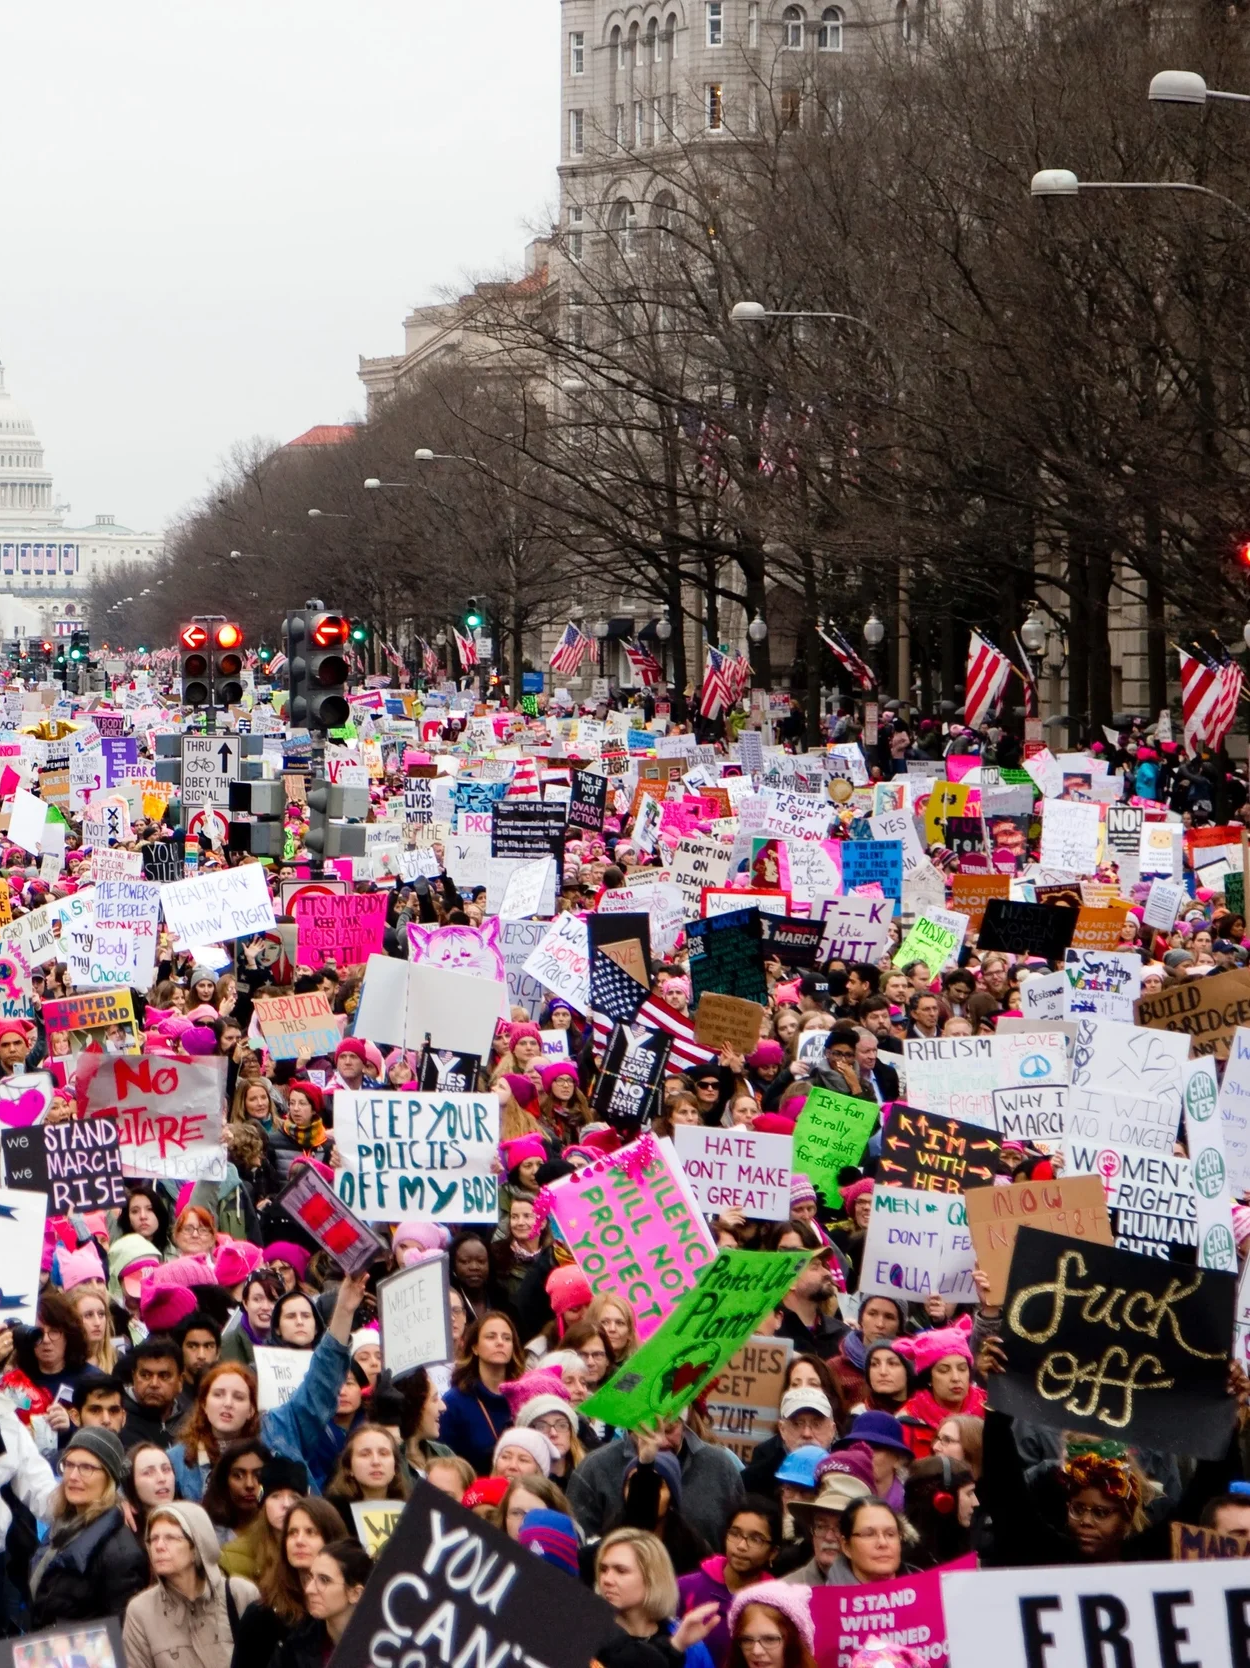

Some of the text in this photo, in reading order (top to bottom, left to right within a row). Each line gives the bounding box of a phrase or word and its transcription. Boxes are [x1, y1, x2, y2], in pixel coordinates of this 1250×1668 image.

[186, 741, 211, 751] THRU
[126, 766, 147, 777] FEAR
[577, 772, 598, 781] this
[982, 769, 999, 784] NO!
[185, 777, 210, 787] OBEY
[405, 778, 431, 793] BLACK
[581, 782, 601, 794] NOT
[405, 795, 432, 808] LIVES
[571, 802, 602, 814] OVARY
[776, 791, 825, 810] TRUMP
[407, 811, 432, 823] MATTER
[569, 813, 602, 827] ACTION
[777, 802, 826, 819] IS GUILTY
[768, 817, 823, 839] TREASON
[879, 818, 906, 832] YES
[1108, 809, 1142, 832] NO!
[677, 842, 732, 860] ABORTION
[693, 859, 709, 872] ON
[167, 882, 213, 907] HEALTH
[174, 903, 272, 945] HUMAN RIGHT
[774, 931, 819, 945] MARCH
[1073, 930, 1119, 941] NOISY
[96, 937, 128, 964] Body
[58, 995, 115, 1014] UNITED
[256, 996, 329, 1021] DISPUTIN
[1138, 985, 1201, 1025] BUILD
[279, 1020, 306, 1031] THIS
[907, 1040, 992, 1060] RACISM
[1001, 1096, 1043, 1113] WHY
[357, 1100, 494, 1142] KEEP YOUR
[6, 1121, 117, 1152] we STAND
[928, 1130, 966, 1155] I'M
[357, 1139, 468, 1173] POLICIES
[704, 1135, 756, 1159] HATE
[10, 1167, 33, 1180] we
[47, 1149, 121, 1180] MARCH
[916, 1150, 967, 1179] WITH
[738, 1165, 790, 1188] MAKE
[53, 1177, 127, 1209] RISE
[339, 1171, 498, 1215] OFF MY BODY
[707, 1188, 776, 1211] GREAT!
[993, 1187, 1063, 1216] NOW
[875, 1197, 920, 1215] MEN
[888, 1228, 939, 1247] DON'T
[422, 1508, 517, 1616] YOU
[840, 1588, 916, 1613] I STAND
[840, 1612, 894, 1633] WITH
